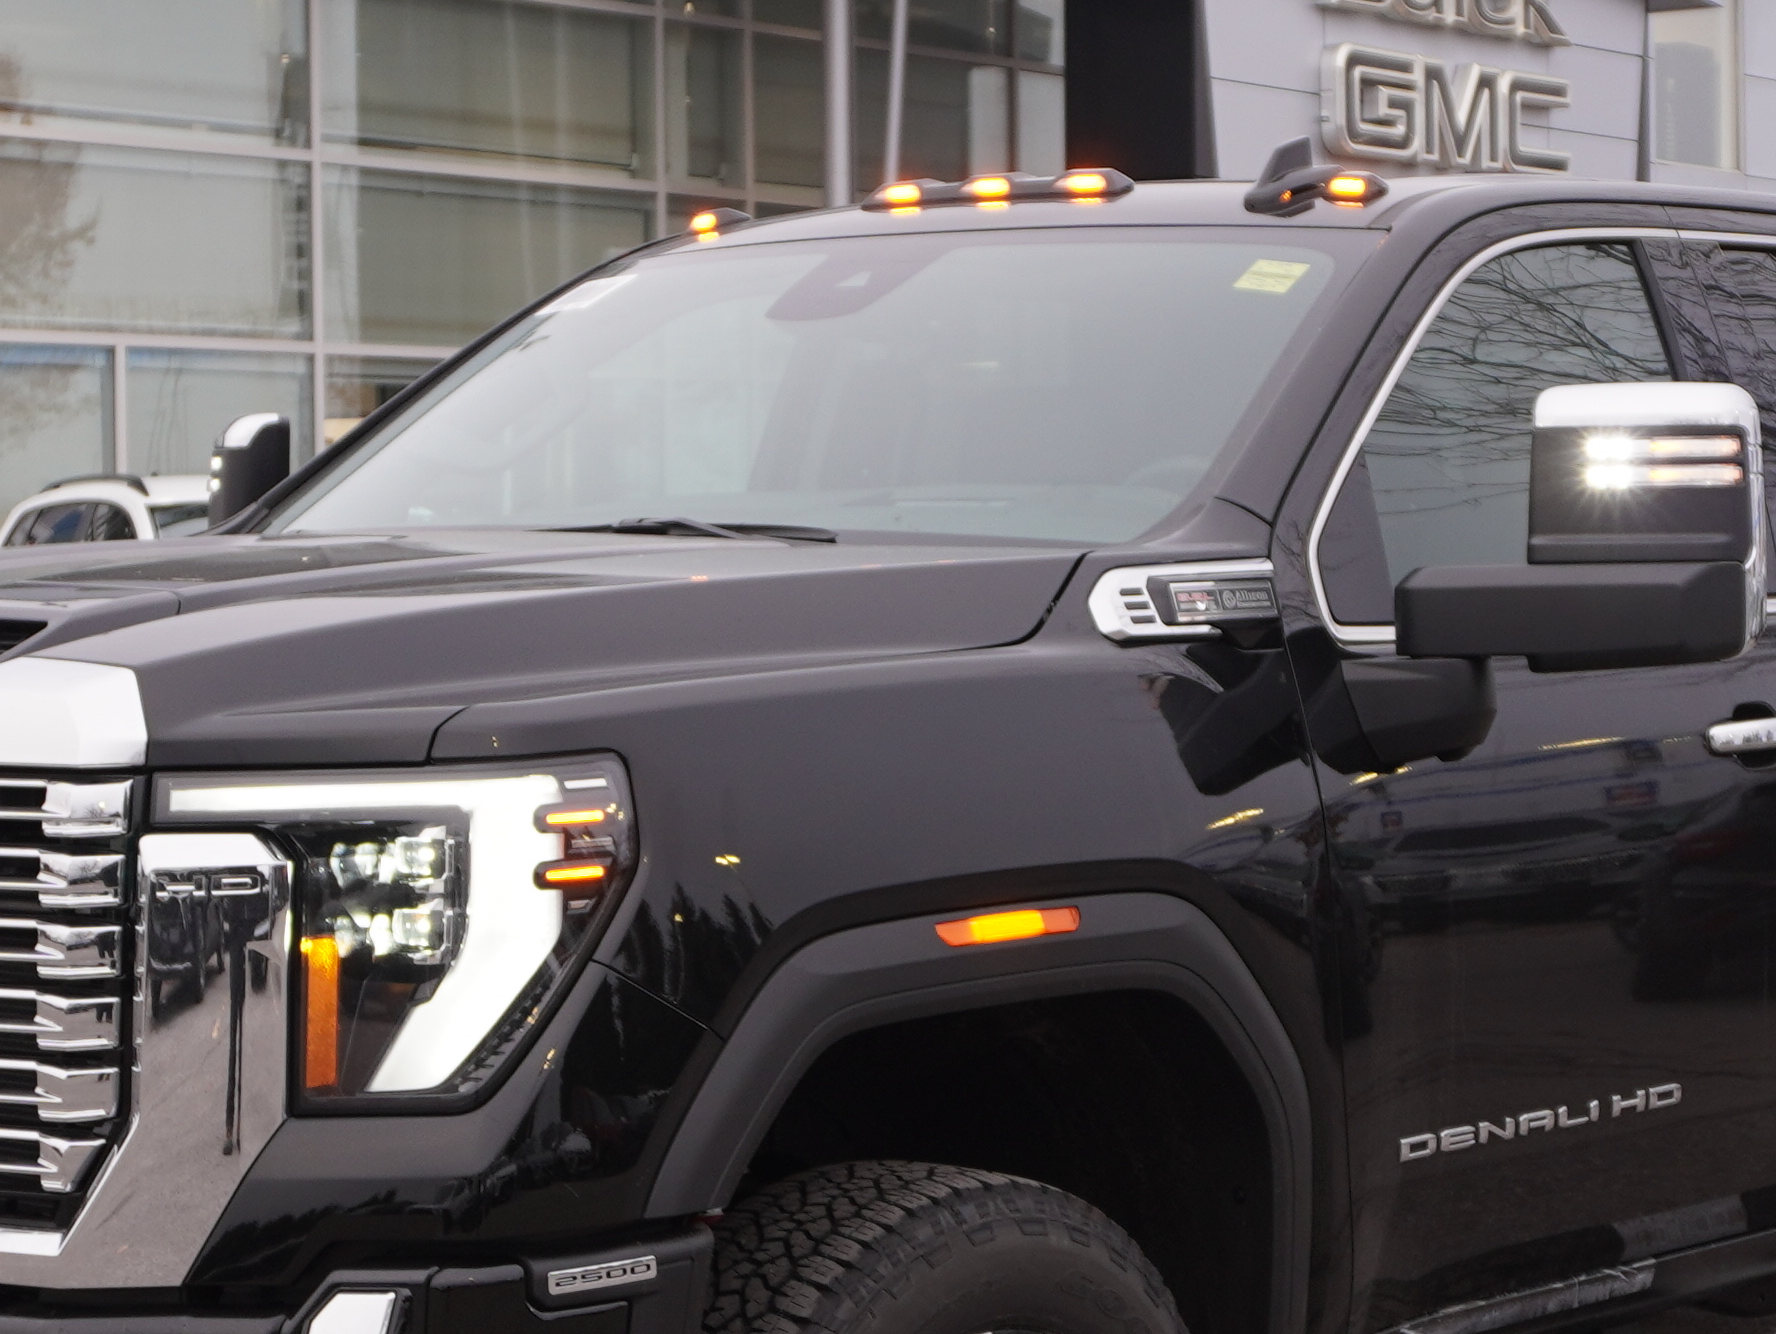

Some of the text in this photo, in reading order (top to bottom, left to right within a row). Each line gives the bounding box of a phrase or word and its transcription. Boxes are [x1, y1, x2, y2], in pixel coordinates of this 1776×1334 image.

[1322, 42, 1572, 173] GMC
[1399, 1082, 1683, 1163] DENALI HD
[554, 1263, 652, 1288] 2500
